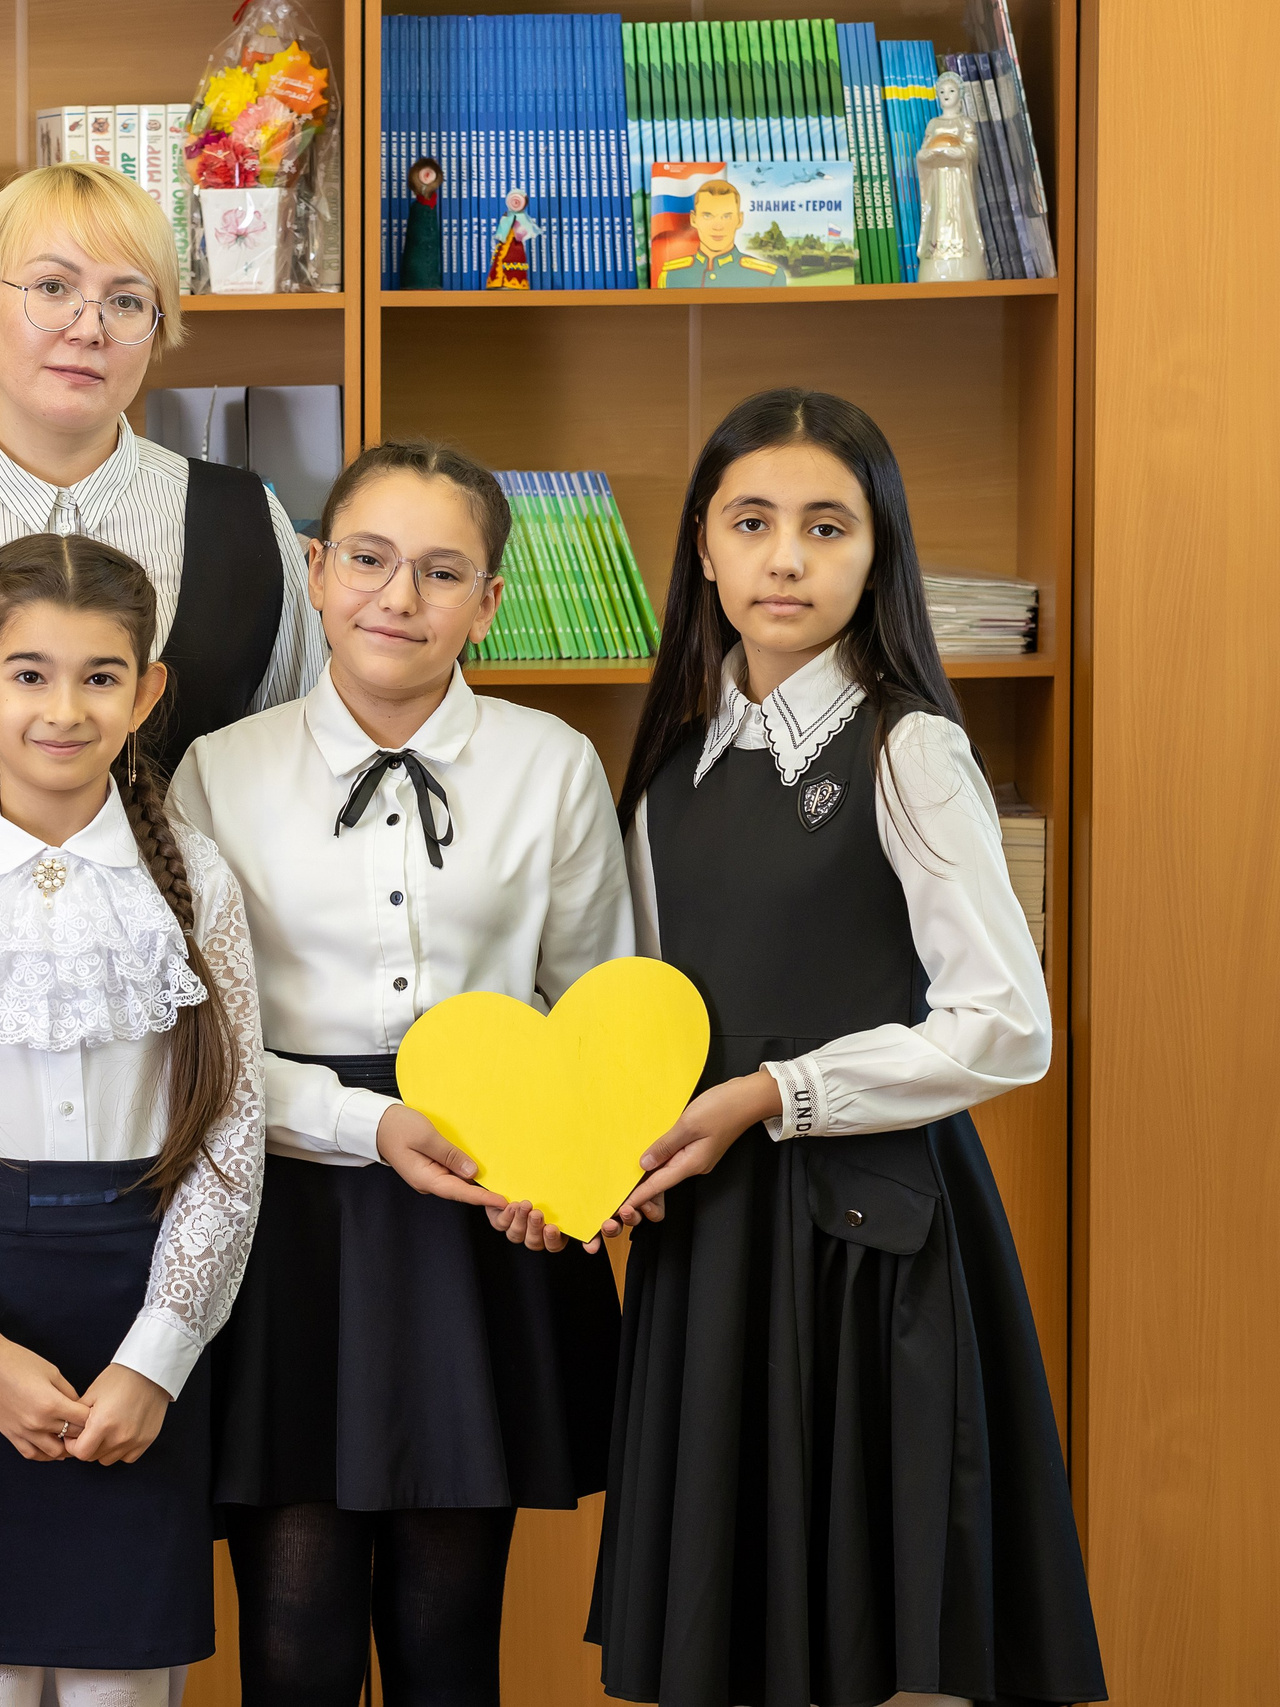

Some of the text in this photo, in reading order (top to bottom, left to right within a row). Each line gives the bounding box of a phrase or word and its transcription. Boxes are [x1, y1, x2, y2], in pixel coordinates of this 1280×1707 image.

[749, 200, 842, 212] ЗНАНИЕ ГЕРОИ
[856, 208, 864, 229] МОЯ
[866, 208, 874, 229] МОЯ
[876, 208, 884, 229] МОЯ
[885, 207, 894, 228] МОЯ
